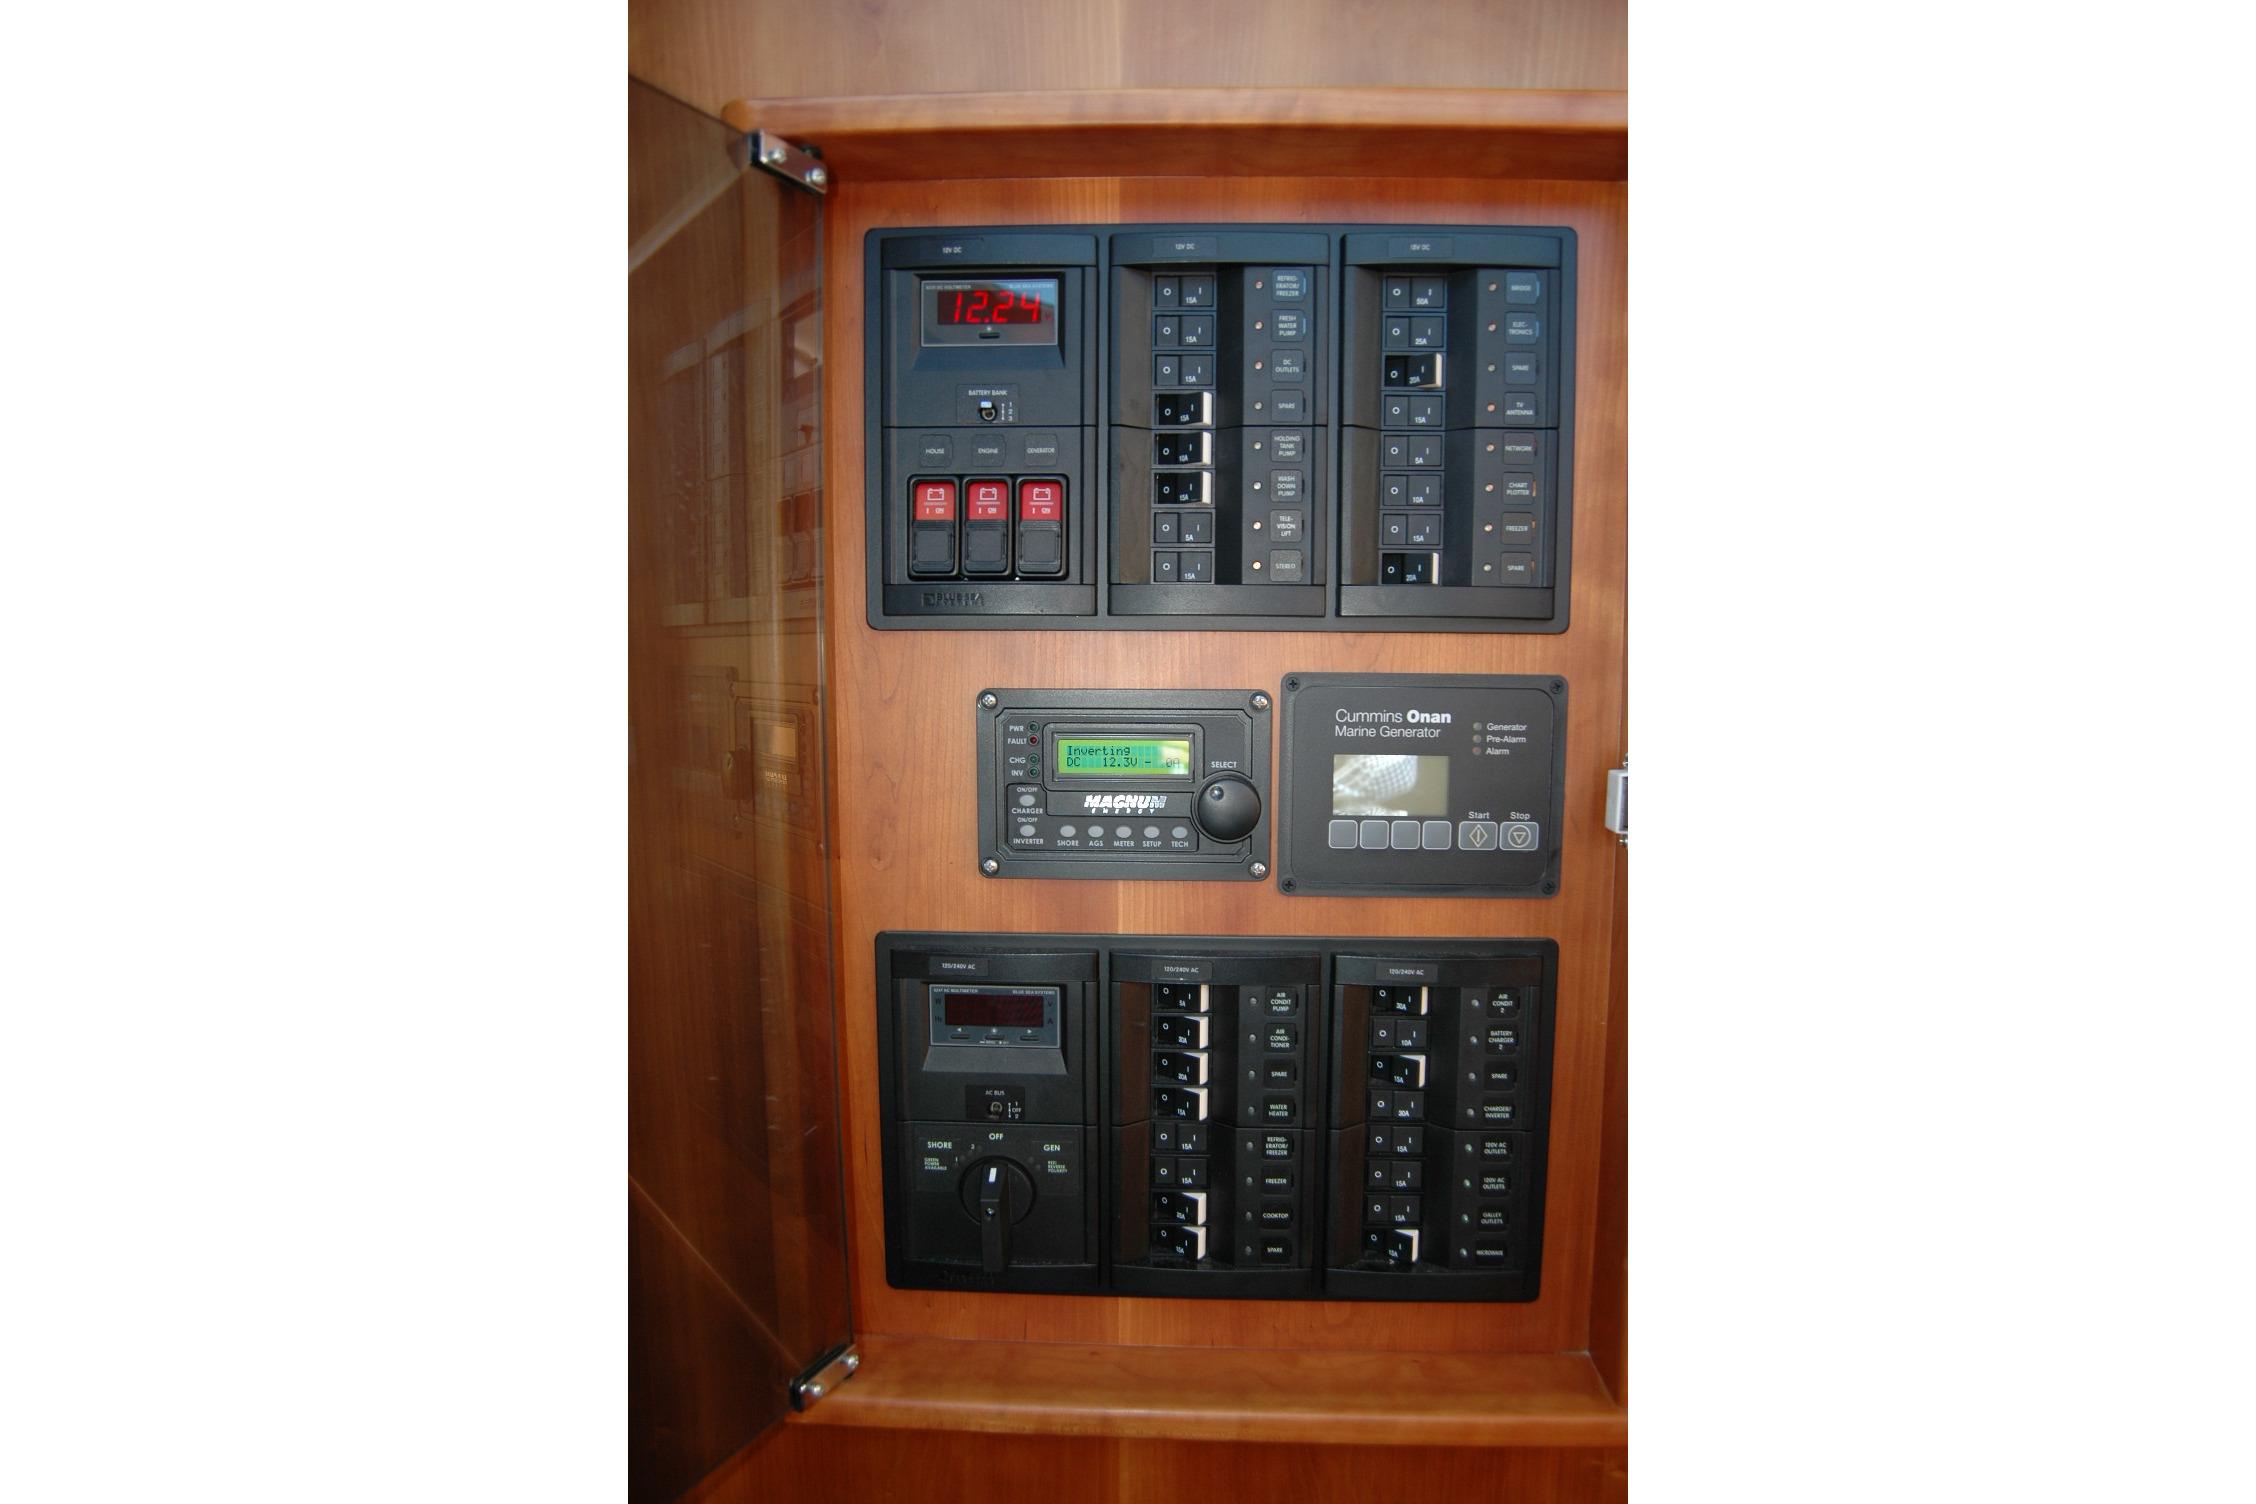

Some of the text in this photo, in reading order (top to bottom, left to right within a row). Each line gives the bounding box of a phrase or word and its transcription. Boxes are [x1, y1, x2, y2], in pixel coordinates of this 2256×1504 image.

[954, 291, 1040, 323] 12.24
[1335, 709, 1451, 724] Cummins Onan
[1487, 723, 1526, 731] Generator
[1335, 726, 1440, 738] Marine Generator
[1486, 735, 1526, 743] Pre-Alarm
[1067, 745, 1130, 756] Inverting
[1485, 747, 1509, 755] Alarm
[1067, 757, 1080, 767] DC
[1103, 757, 1137, 767] 12.3V
[1211, 761, 1237, 769] SELECT
[1011, 769, 1023, 777] INV
[1084, 795, 1167, 809] MAGNUM
[1468, 811, 1489, 819] Start
[1510, 812, 1530, 820] Stop
[1013, 837, 1044, 845] INVERTER
